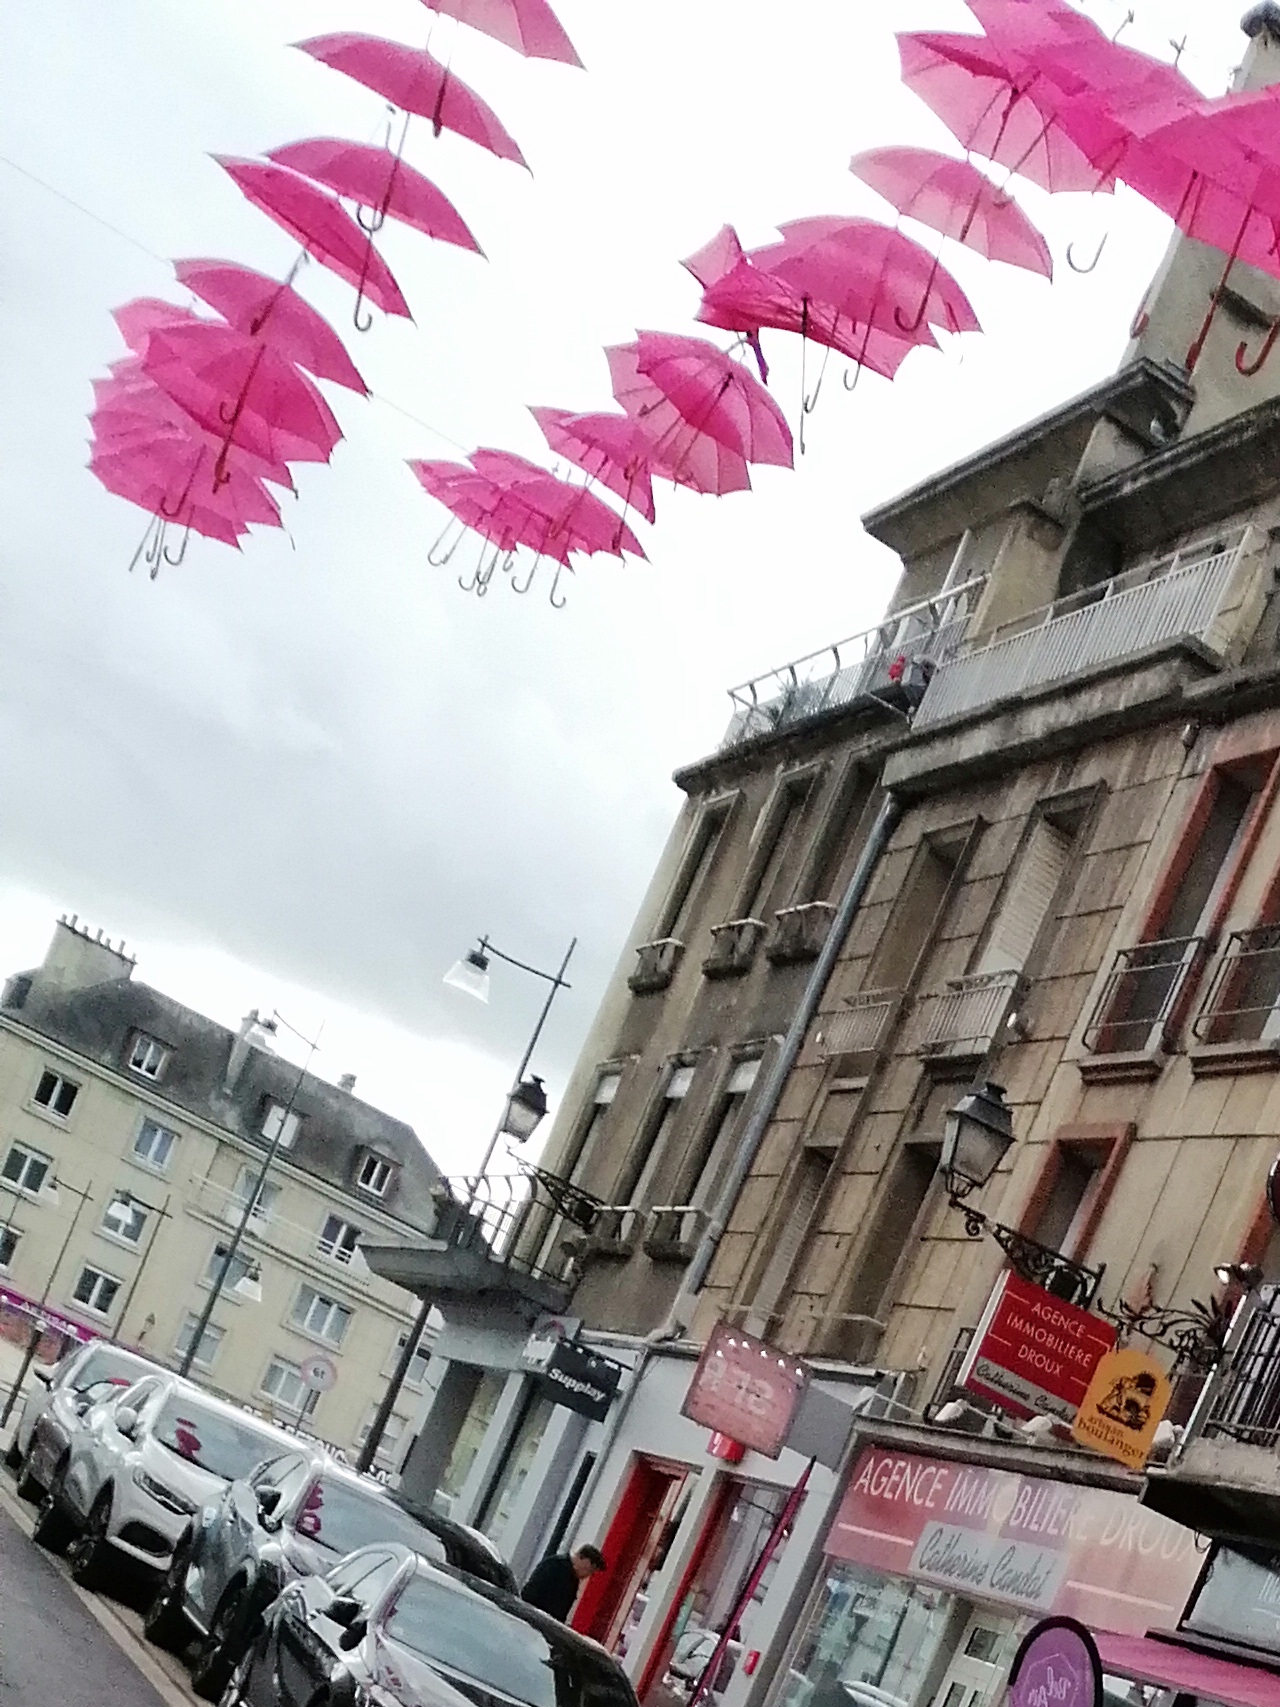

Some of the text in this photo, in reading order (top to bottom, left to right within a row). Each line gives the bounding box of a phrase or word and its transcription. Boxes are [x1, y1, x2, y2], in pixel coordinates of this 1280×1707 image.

[1031, 1302, 1087, 1338] AGENCE
[1017, 1344, 1063, 1377] DROUX
[549, 1368, 606, 1401] Supplay
[1077, 1417, 1146, 1459] boulanger
[854, 1456, 948, 1509] AGENCE
[1101, 1513, 1209, 1562] DROUX
